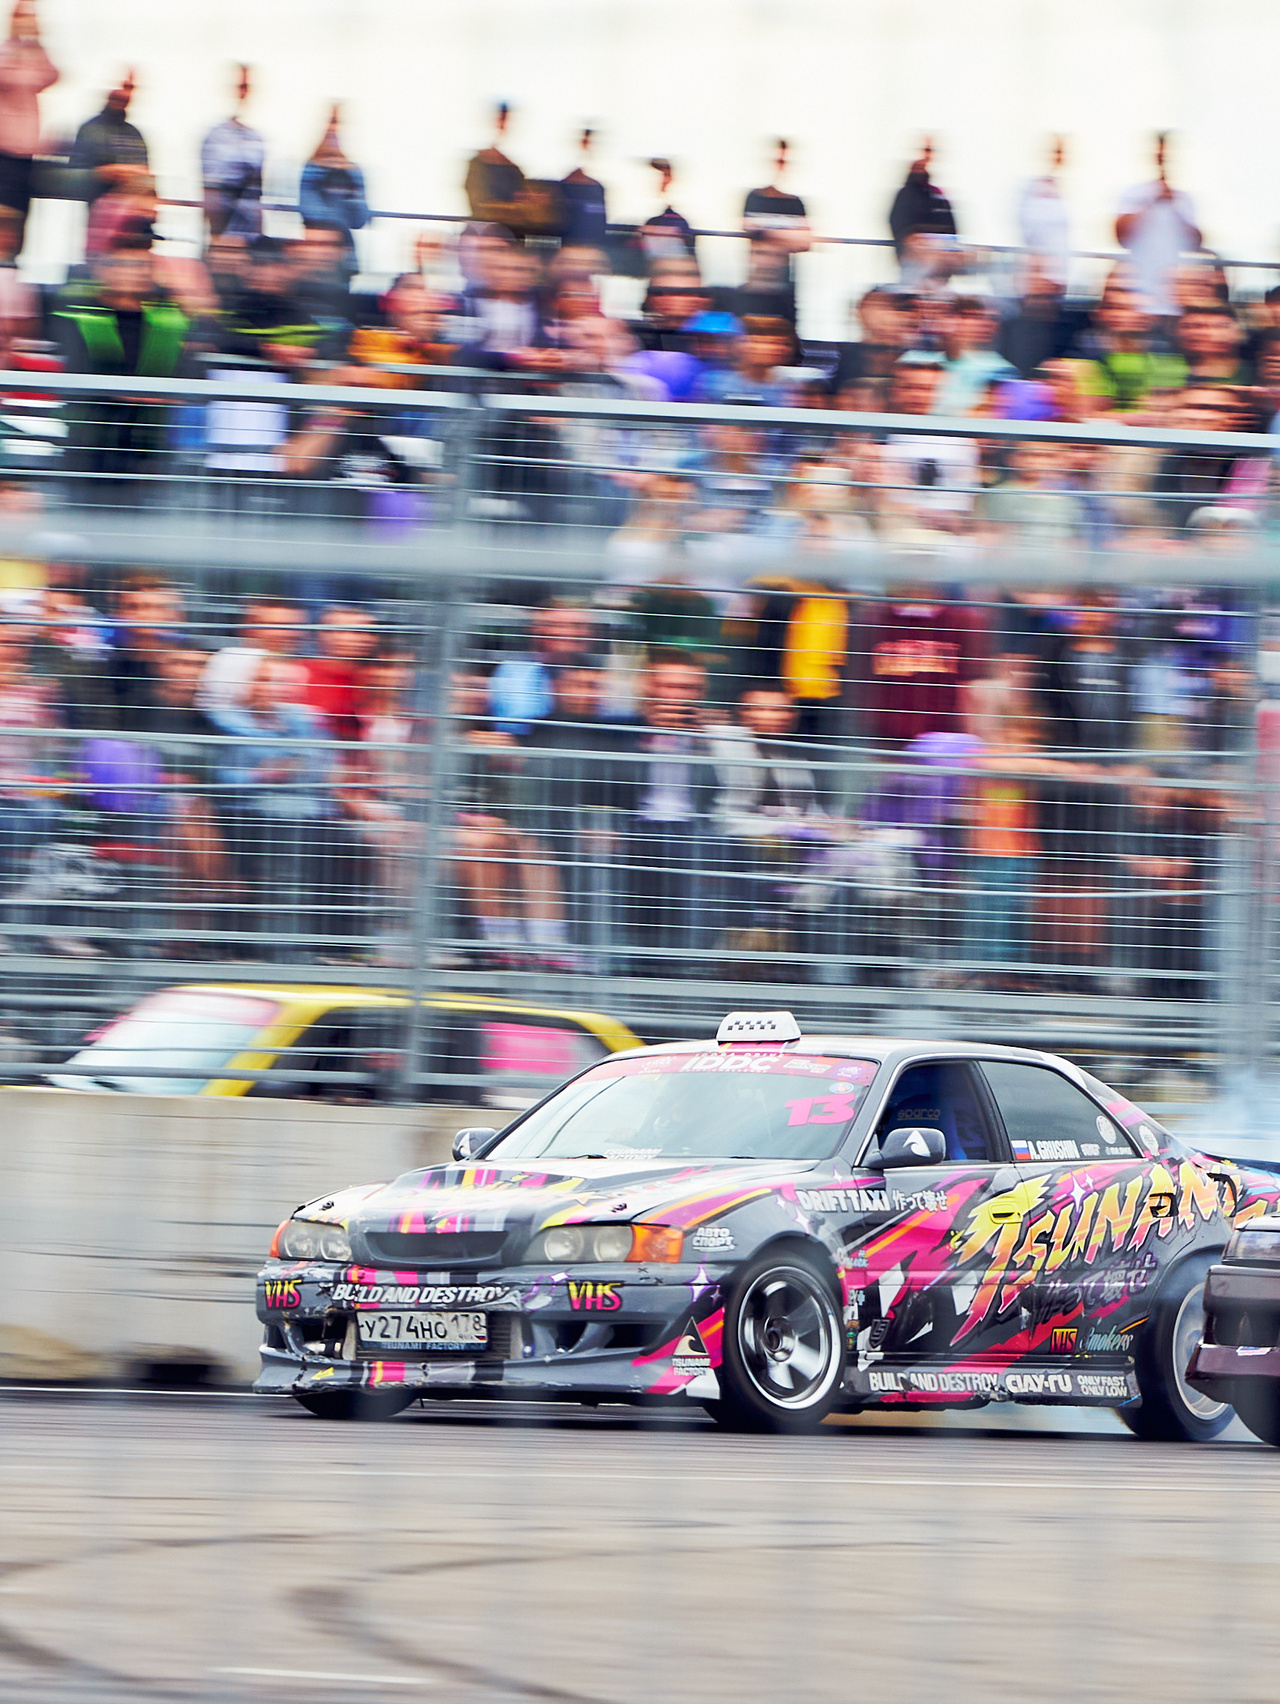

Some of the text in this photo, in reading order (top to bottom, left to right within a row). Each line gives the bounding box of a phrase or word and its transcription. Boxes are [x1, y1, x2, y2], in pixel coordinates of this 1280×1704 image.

[681, 1056, 780, 1071] IDDC
[785, 1093, 856, 1127] 13
[897, 1108, 941, 1120] sparco
[796, 1190, 891, 1211] DRIFT TAXI
[265, 1280, 302, 1309] VHS
[380, 1286, 420, 1304] AND
[567, 1281, 623, 1311] VHS
[382, 1342, 467, 1351] TSUNAMI FACTORY
[1053, 1330, 1077, 1352] VHS
[1079, 1325, 1133, 1351] Smokers
[671, 1357, 711, 1367] TSUNAMI
[909, 1373, 939, 1392] AND
[1077, 1374, 1125, 1387] ONLY FAST
[1081, 1384, 1128, 1397] ONLY LOW
